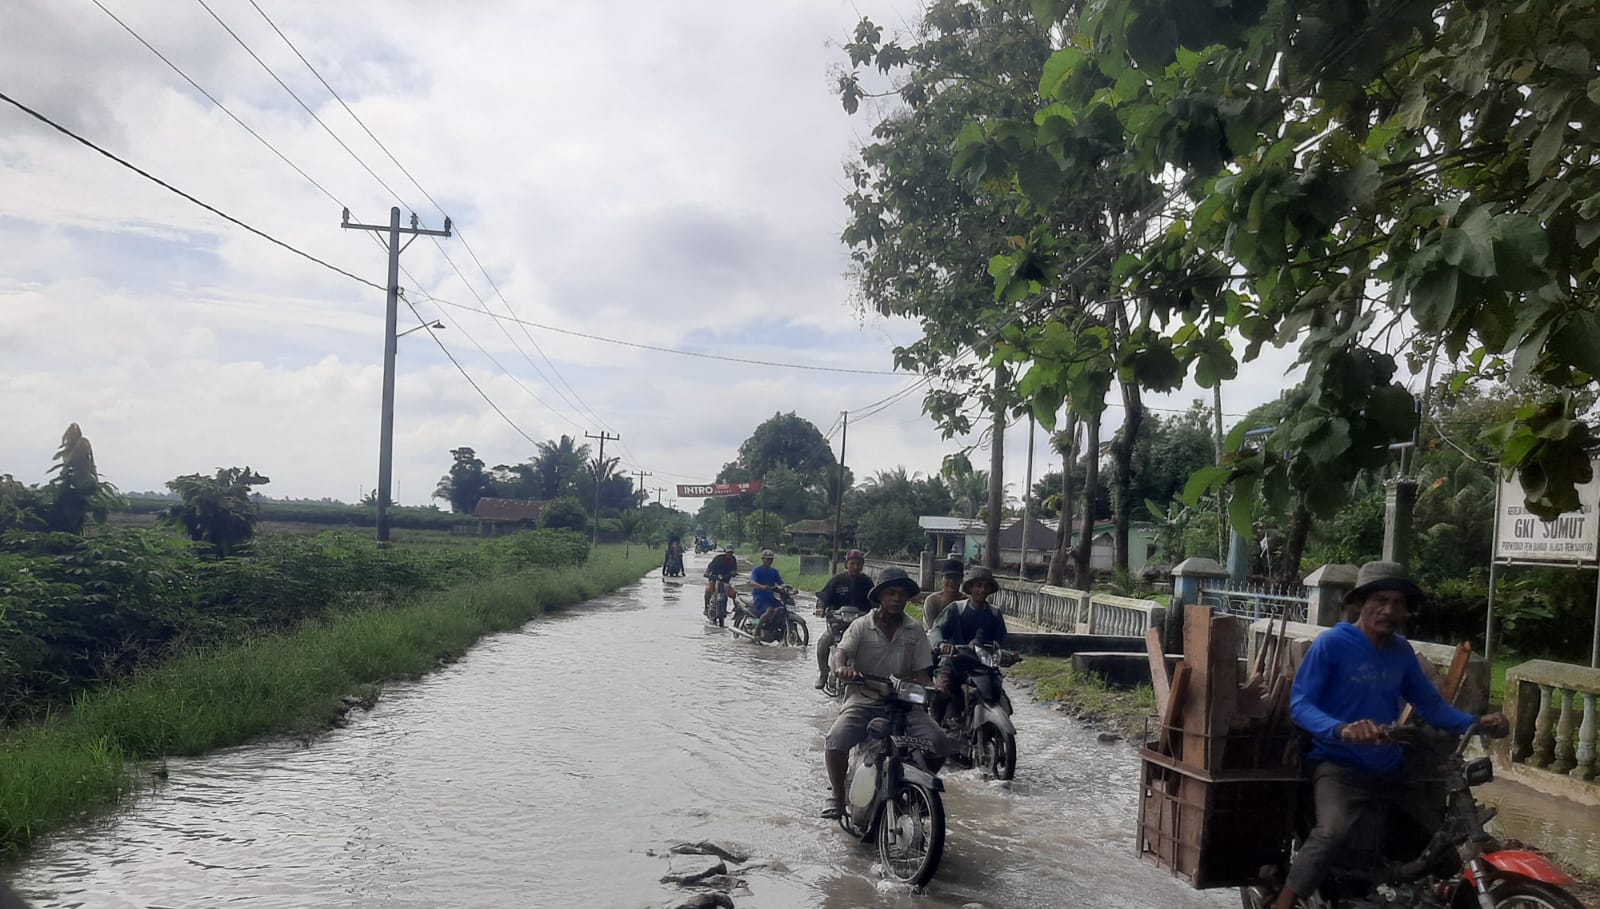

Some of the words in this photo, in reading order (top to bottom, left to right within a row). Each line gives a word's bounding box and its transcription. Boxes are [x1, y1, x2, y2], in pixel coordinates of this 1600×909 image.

[684, 486, 713, 494] INTRO
[1514, 518, 1535, 538] GKI
[1543, 517, 1585, 539] SUMUT
